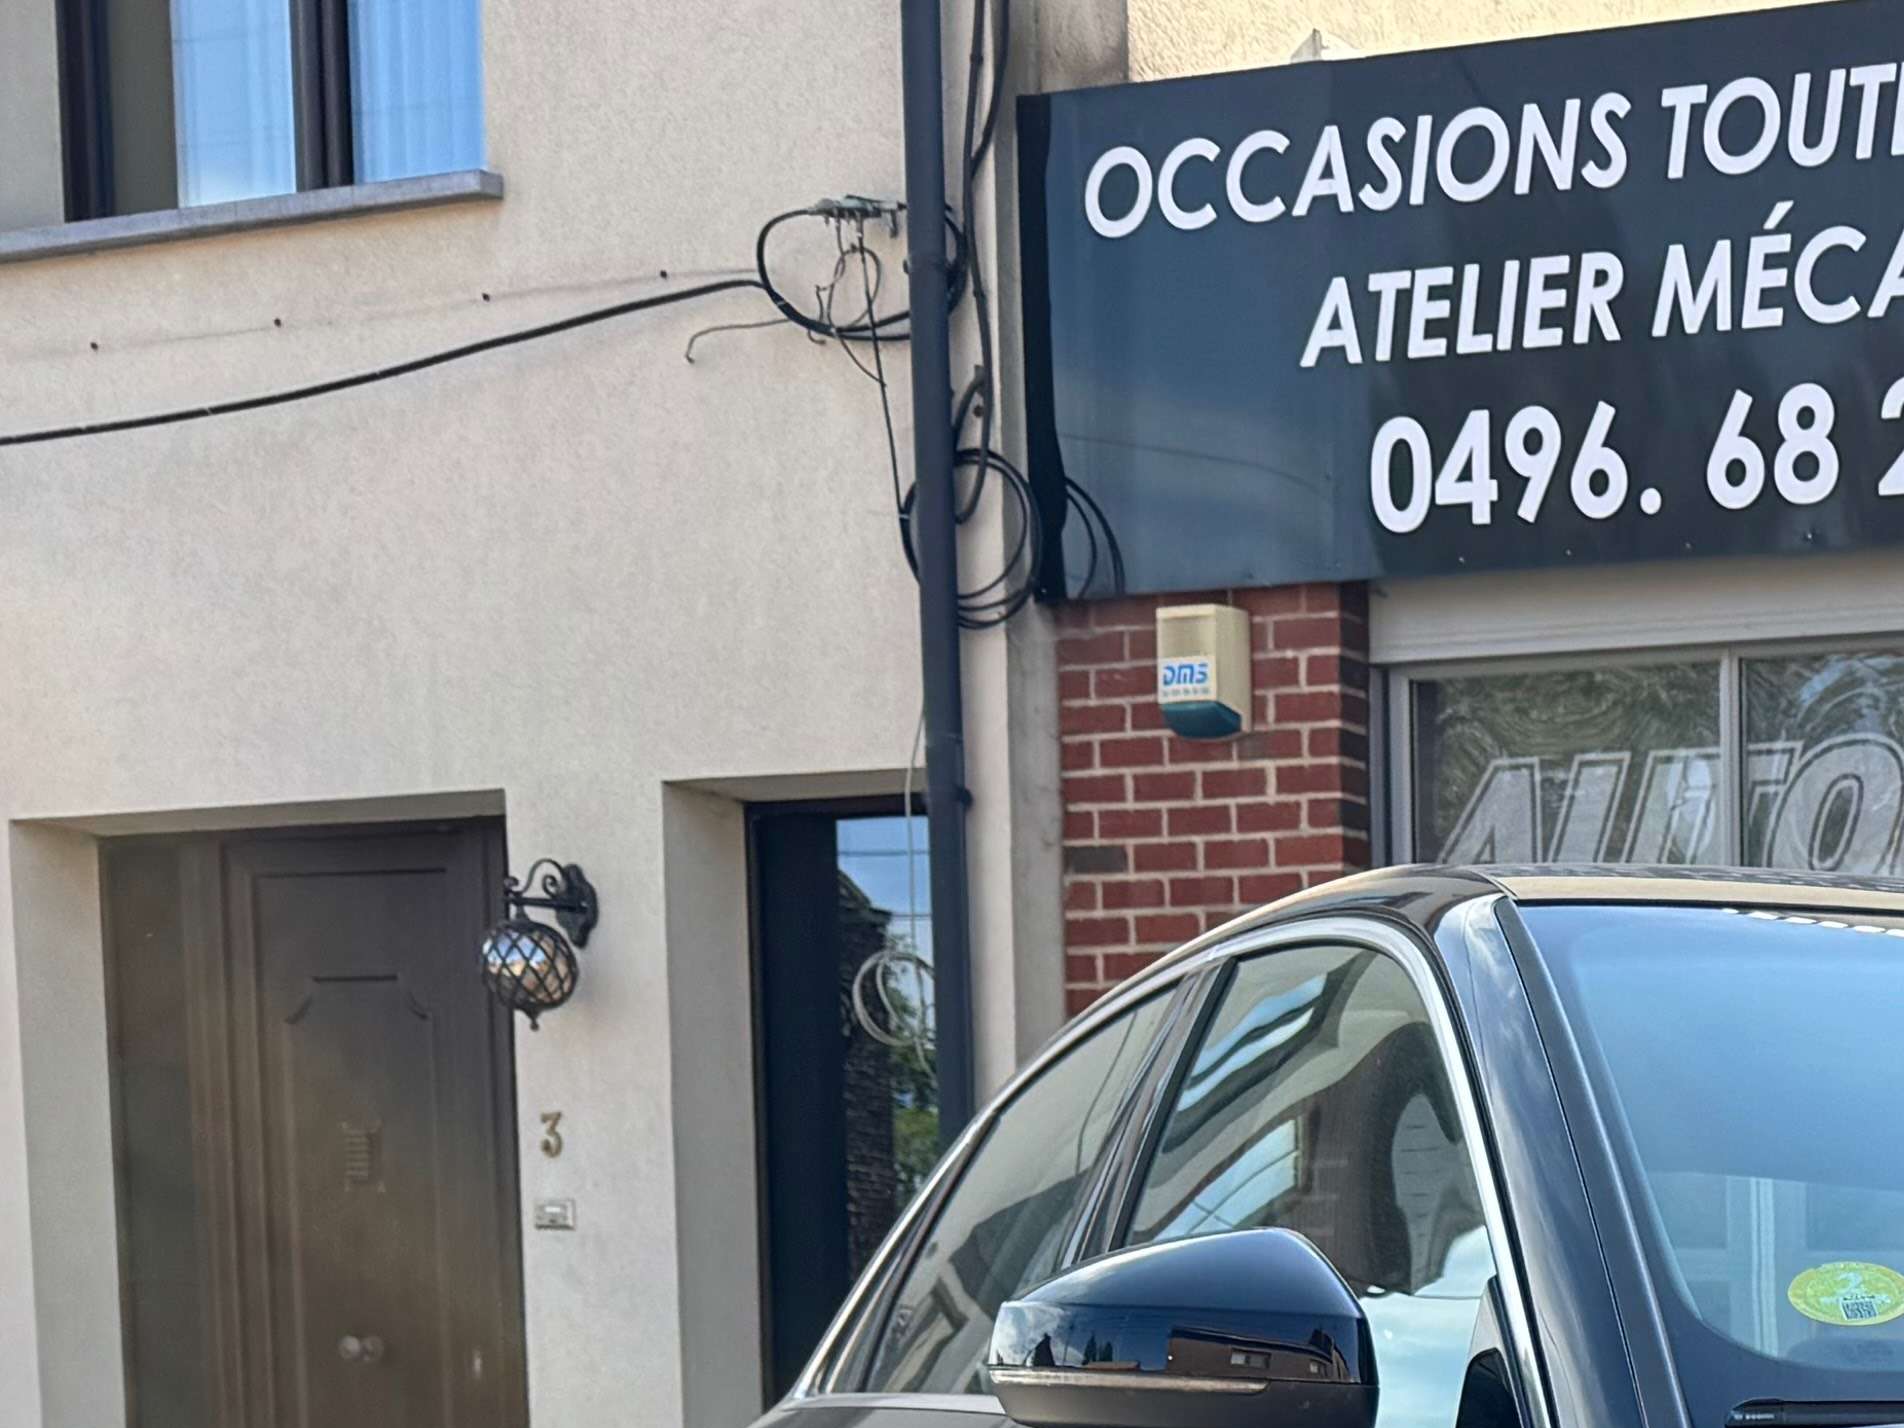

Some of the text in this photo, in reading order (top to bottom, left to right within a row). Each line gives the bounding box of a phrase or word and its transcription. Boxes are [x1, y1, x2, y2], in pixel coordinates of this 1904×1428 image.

[1085, 92, 1631, 238] OCCASIONS
[1300, 252, 1624, 367] ATELIER
[1370, 401, 1662, 533] 0496.
[1707, 383, 1839, 510] 68
[1540, 1111, 1563, 1159] 3
